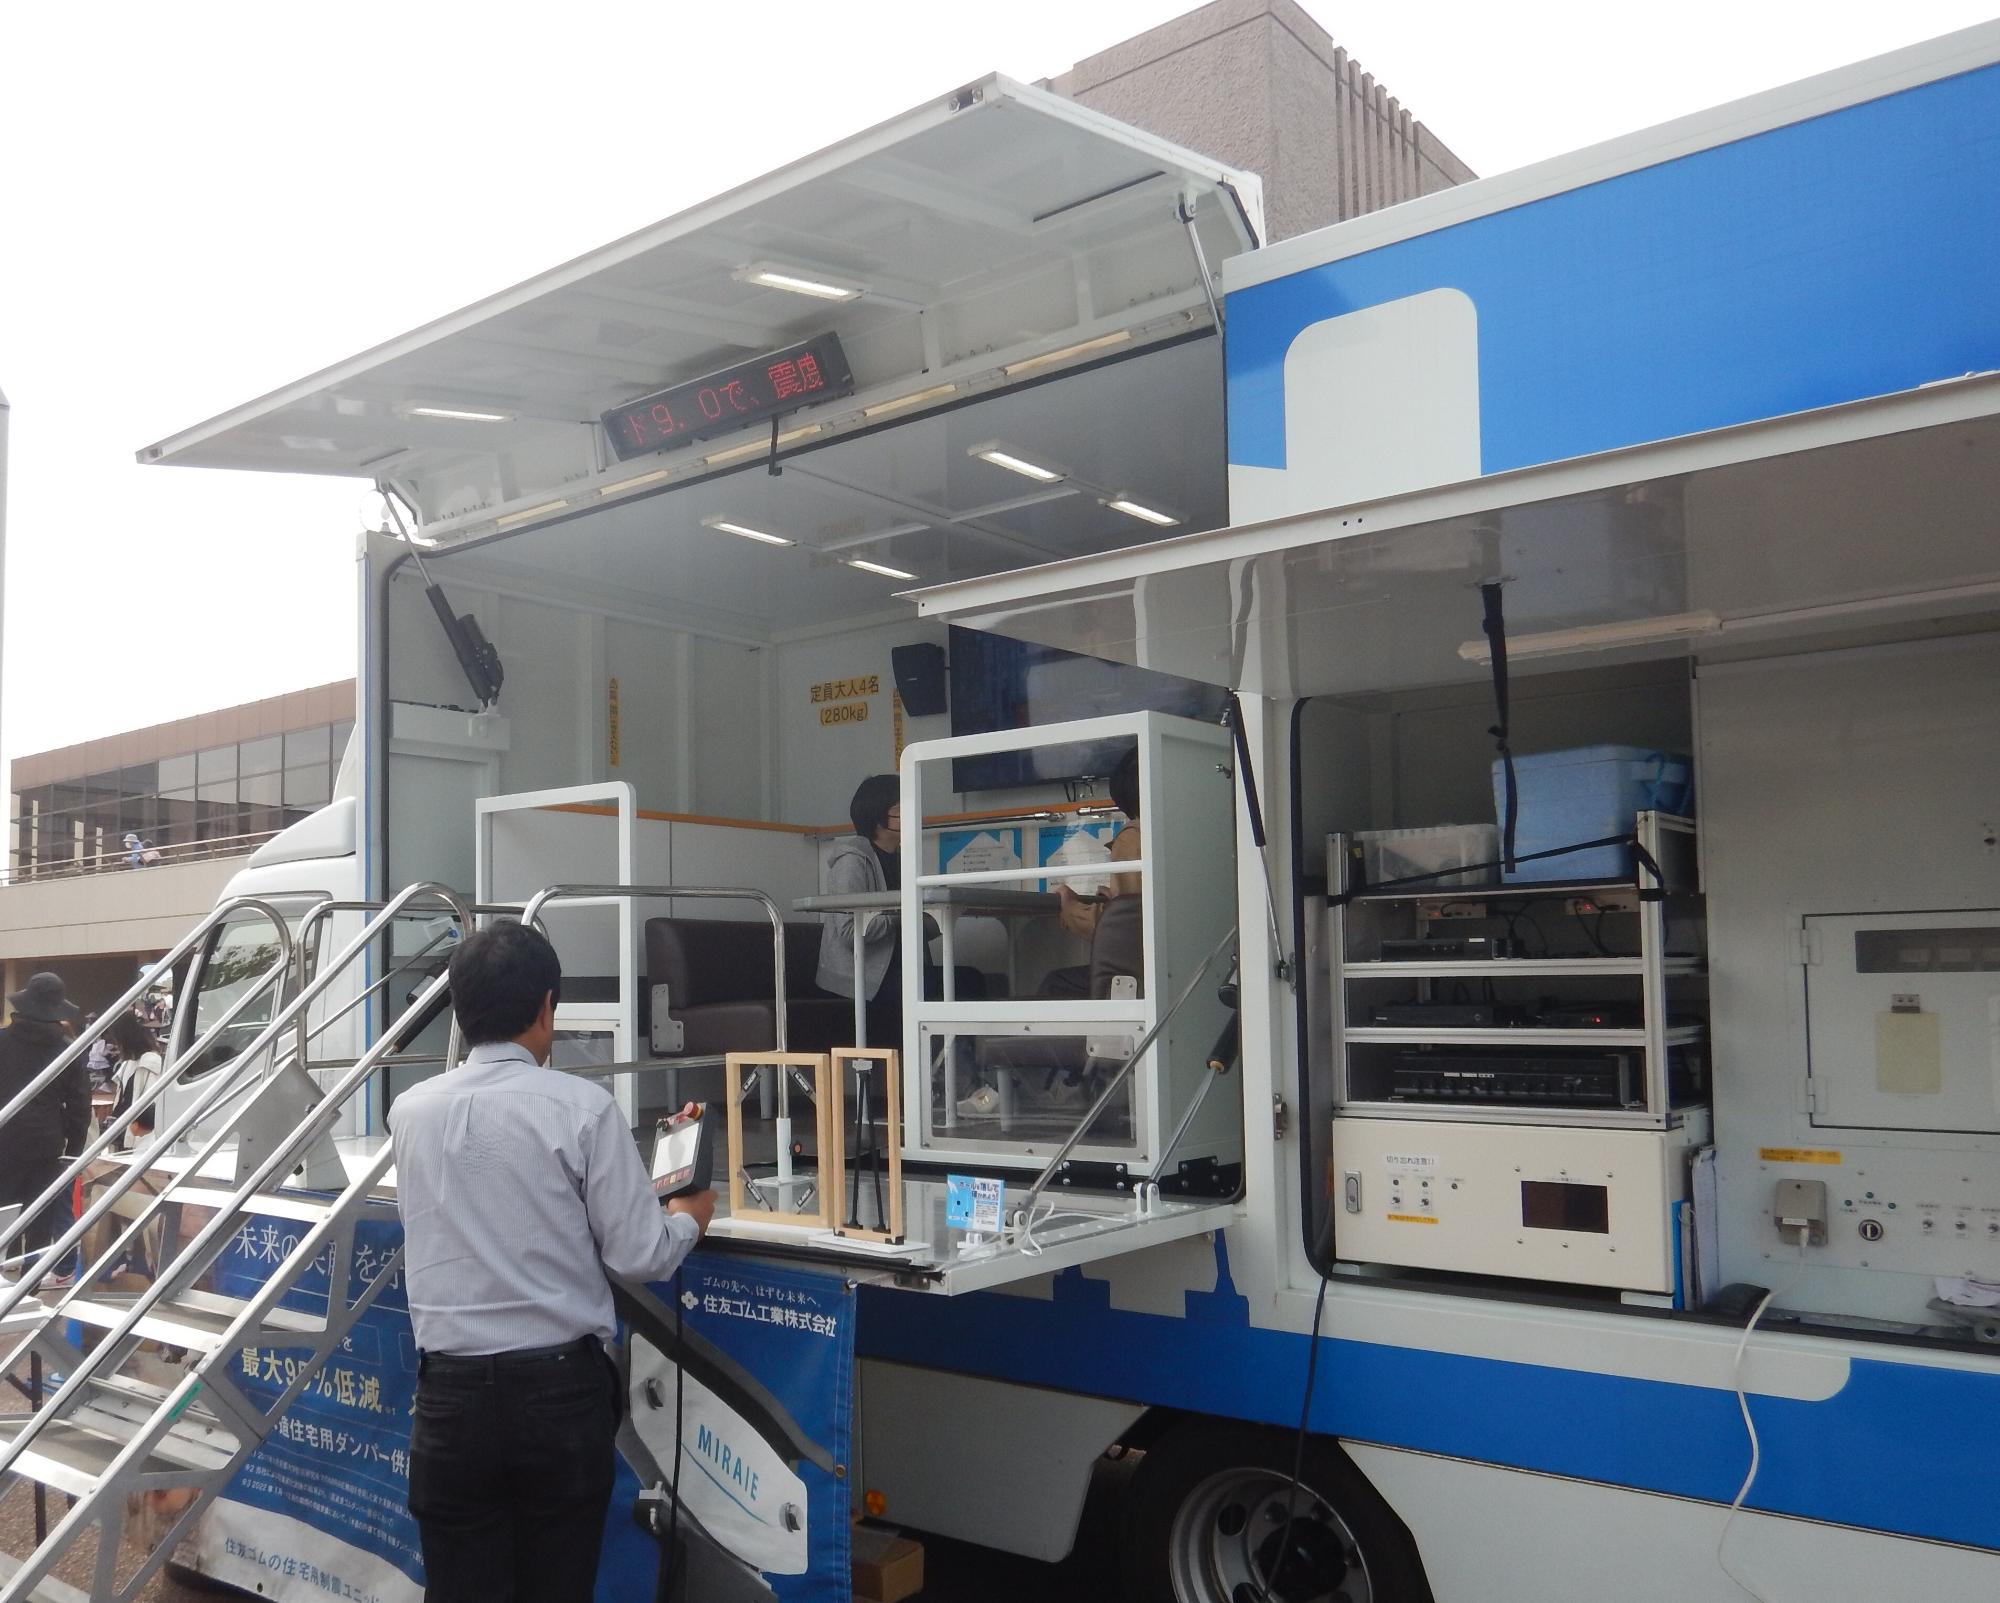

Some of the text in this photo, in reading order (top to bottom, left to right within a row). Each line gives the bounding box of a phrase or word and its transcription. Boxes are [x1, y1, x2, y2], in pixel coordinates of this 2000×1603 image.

[809, 675, 879, 703] 定員大人4名
[819, 702, 869, 726] (280kg)
[234, 1224, 405, 1290] 未来のを
[703, 1294, 837, 1337] 住友ゴム工業株式会社
[273, 1414, 410, 1479] 造住宅用ダンパー供
[697, 1423, 759, 1501] MIRAIE
